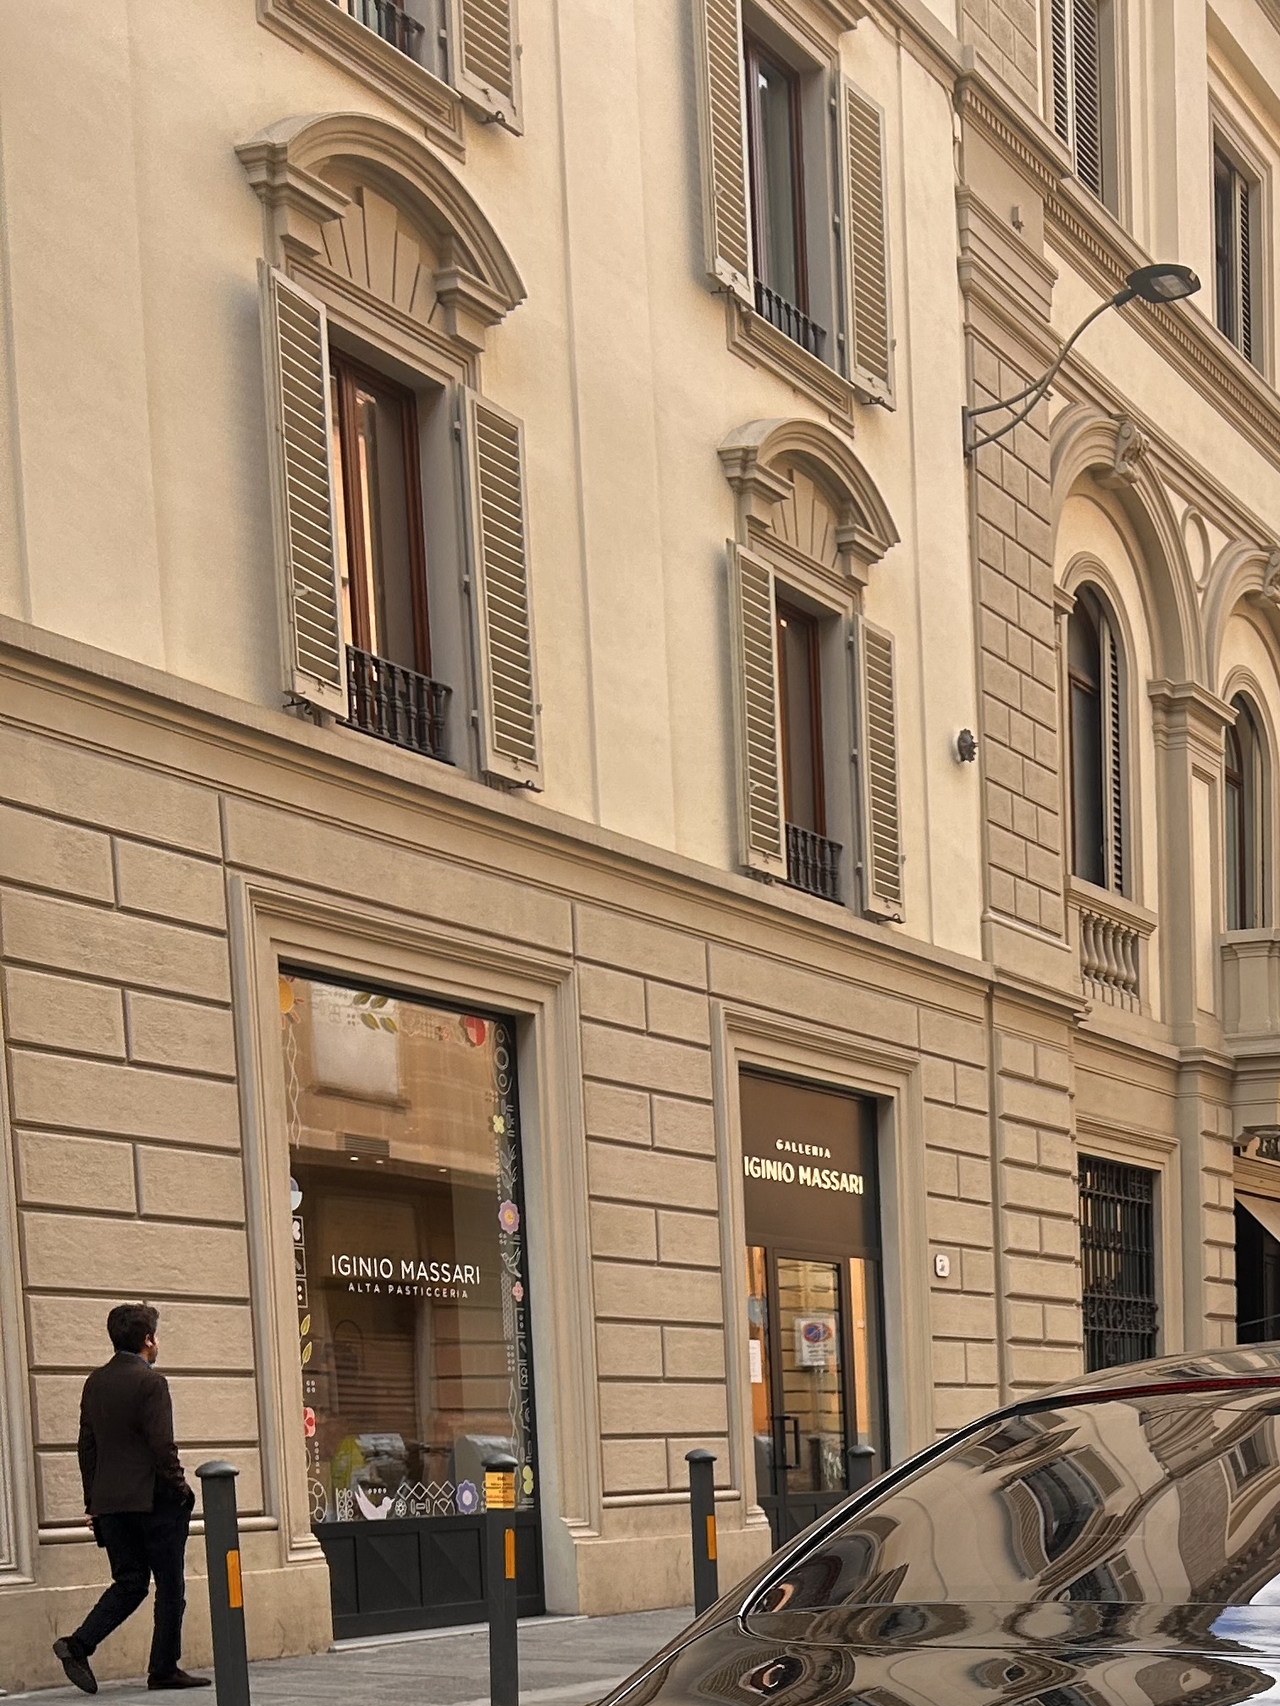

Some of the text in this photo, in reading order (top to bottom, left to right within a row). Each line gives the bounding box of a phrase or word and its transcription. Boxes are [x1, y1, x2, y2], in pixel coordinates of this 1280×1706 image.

[775, 1139, 831, 1158] GALLERIA
[743, 1156, 864, 1194] IGINIO MASSARI
[331, 1254, 480, 1285] IGINIO MASSARI
[348, 1282, 468, 1299] ALTA PASTICCERIA
